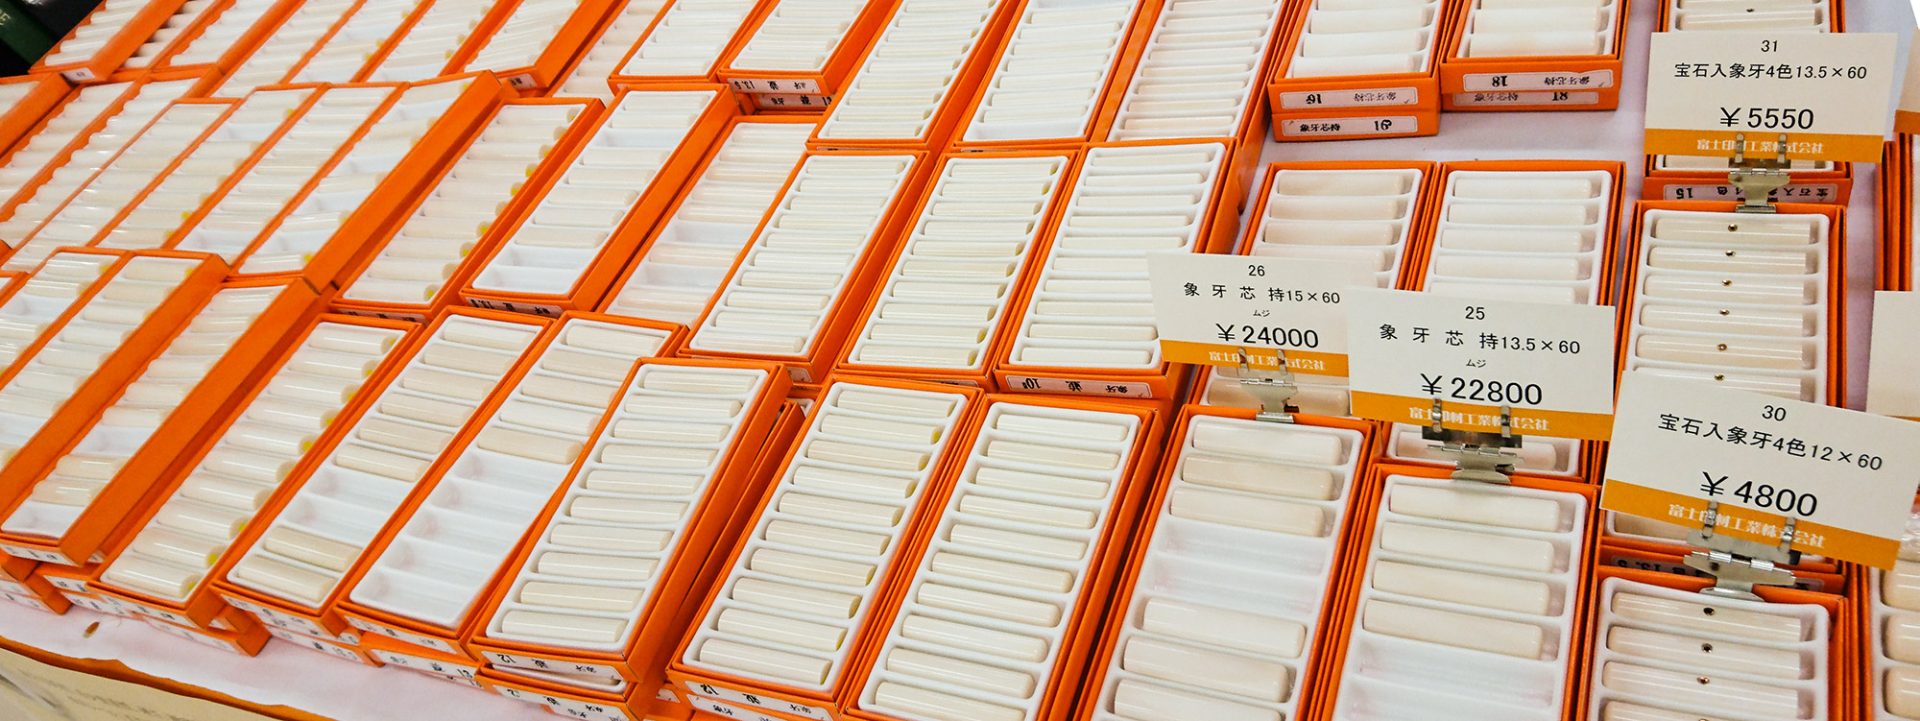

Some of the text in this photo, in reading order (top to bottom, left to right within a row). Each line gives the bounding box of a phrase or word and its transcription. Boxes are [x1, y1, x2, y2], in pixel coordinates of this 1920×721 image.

[1761, 40, 1778, 53] 31
[1492, 75, 1508, 87] 18
[1676, 187, 1693, 200] 15
[1248, 264, 1265, 277] 26
[1253, 309, 1270, 317] ムジ
[1465, 306, 1485, 320] 25
[1466, 358, 1487, 368] ムジ
[1762, 405, 1786, 421] 30
